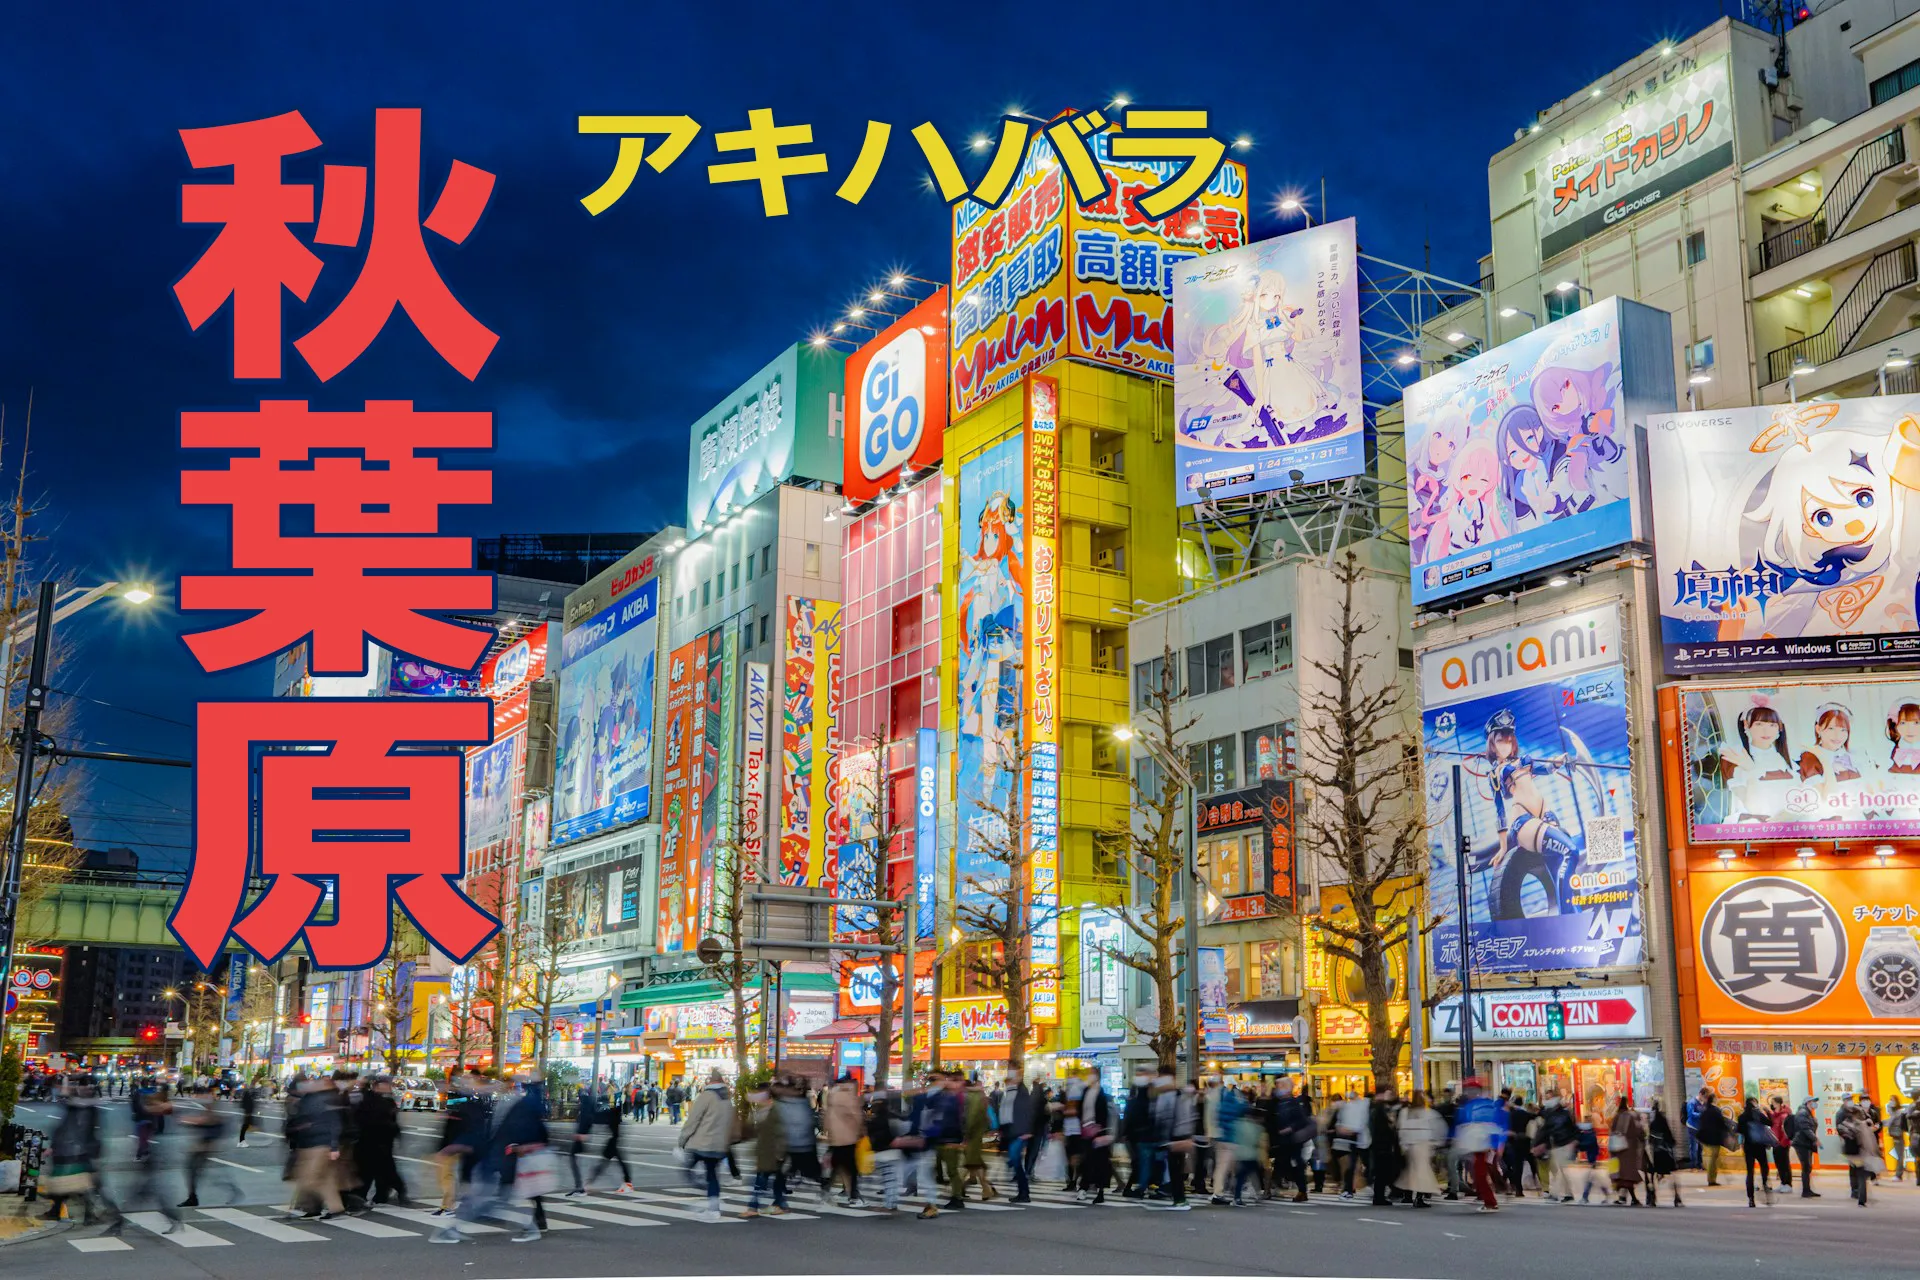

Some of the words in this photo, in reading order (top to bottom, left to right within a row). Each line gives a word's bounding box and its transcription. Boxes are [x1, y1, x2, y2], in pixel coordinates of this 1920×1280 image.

[1553, 99, 1715, 218] メイドカジノ
[1603, 190, 1661, 225] GGPOKER
[956, 163, 1064, 290] 激安販売
[954, 224, 1062, 349] 高額買取
[954, 296, 1067, 412] Mulan
[1094, 344, 1146, 368] ムーラン
[964, 382, 995, 412] ムーラン
[995, 368, 1019, 394] AKIBA
[1191, 418, 1207, 430] ミカ
[1656, 416, 1733, 432] HOYOVERSE
[1033, 433, 1055, 446] DVD
[1033, 456, 1055, 469] ゲーム
[1311, 448, 1333, 461] 1/31
[1033, 479, 1055, 491] アイドル
[1036, 469, 1052, 479] CD
[1033, 490, 1055, 503] アニメ
[1033, 503, 1054, 515] コミック
[1034, 514, 1054, 526] ホビー
[1672, 550, 1785, 625] 原神
[621, 594, 649, 625] AKIBA
[1441, 620, 1598, 691] amiami
[1784, 643, 1832, 655] Windows
[671, 657, 685, 684] 4F
[1576, 681, 1614, 698] APEX
[667, 739, 681, 768] 3F
[920, 766, 935, 817] GiGO
[663, 830, 677, 860] 2F
[1571, 872, 1626, 888] amiami
[1853, 905, 1918, 922] チケット
[1716, 898, 1825, 994] 質
[37, 975, 49, 984] 50
[232, 960, 243, 991] AKIBA
[1567, 1002, 1599, 1024] ZIN
[1715, 1039, 1768, 1053] 高価買取
